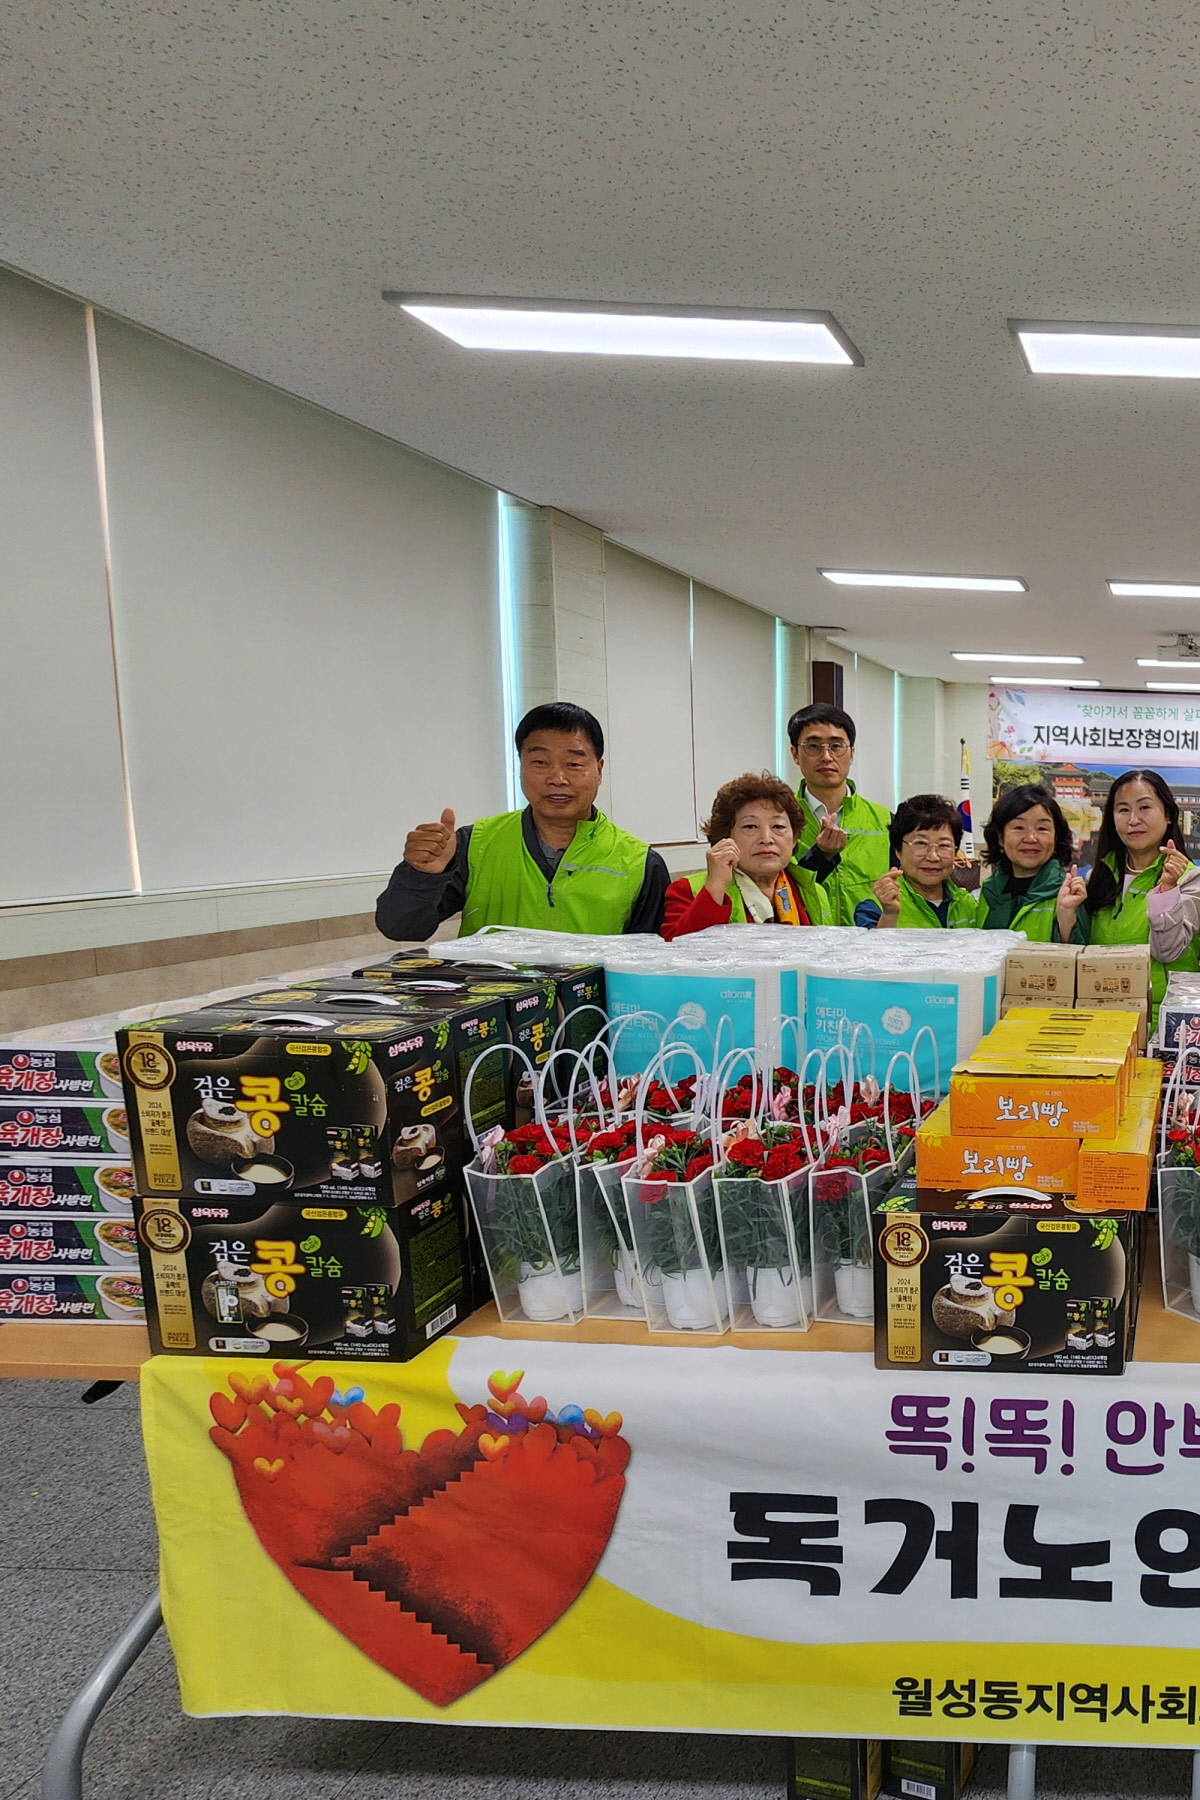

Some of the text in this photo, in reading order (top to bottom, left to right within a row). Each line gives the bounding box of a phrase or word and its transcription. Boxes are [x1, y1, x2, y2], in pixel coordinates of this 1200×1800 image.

[1133, 706, 1179, 720] 꼼꼼하게
[1033, 725, 1199, 751] 지역사회보장협의체
[815, 1006, 847, 1018] 애터미
[477, 1021, 489, 1039] 콩
[530, 1022, 546, 1051] 콩
[175, 1040, 214, 1053] 삼육두유
[387, 1035, 425, 1058] 삼육두유
[29, 1057, 56, 1068] 농심
[139, 1052, 157, 1069] 18
[0, 1065, 94, 1093] 육개장 사발면
[394, 1075, 414, 1093] 검은
[411, 1066, 436, 1102] 콩
[148, 1101, 162, 1109] 2024
[192, 1075, 291, 1138] 검은 콩
[290, 1093, 329, 1117] 칼슘
[995, 1095, 1069, 1128] 보리빵
[35, 1113, 62, 1124] 농심
[0, 1120, 102, 1149] 육개장 사발면
[961, 1148, 1034, 1182] 보리빵
[25, 1173, 53, 1183] 농심
[52, 1194, 93, 1207] 사발면
[430, 1200, 444, 1218] 콩
[191, 1207, 230, 1219] 삼육두유
[27, 1227, 54, 1237] 농심
[154, 1217, 172, 1233] 18
[931, 1220, 968, 1231] 삼육두유
[895, 1231, 912, 1247] 18
[53, 1248, 94, 1260] 사발면
[162, 1264, 178, 1272] 2024
[208, 1238, 307, 1299] 검은 콩
[306, 1255, 344, 1278] 칼슘
[29, 1281, 56, 1291] 농심
[897, 1278, 911, 1286] 2024
[943, 1251, 1035, 1311] 검은 콩
[1035, 1268, 1071, 1291] 칼슘
[0, 1289, 96, 1315] 육개장 사발면
[885, 1394, 1075, 1475] 똑!똑!
